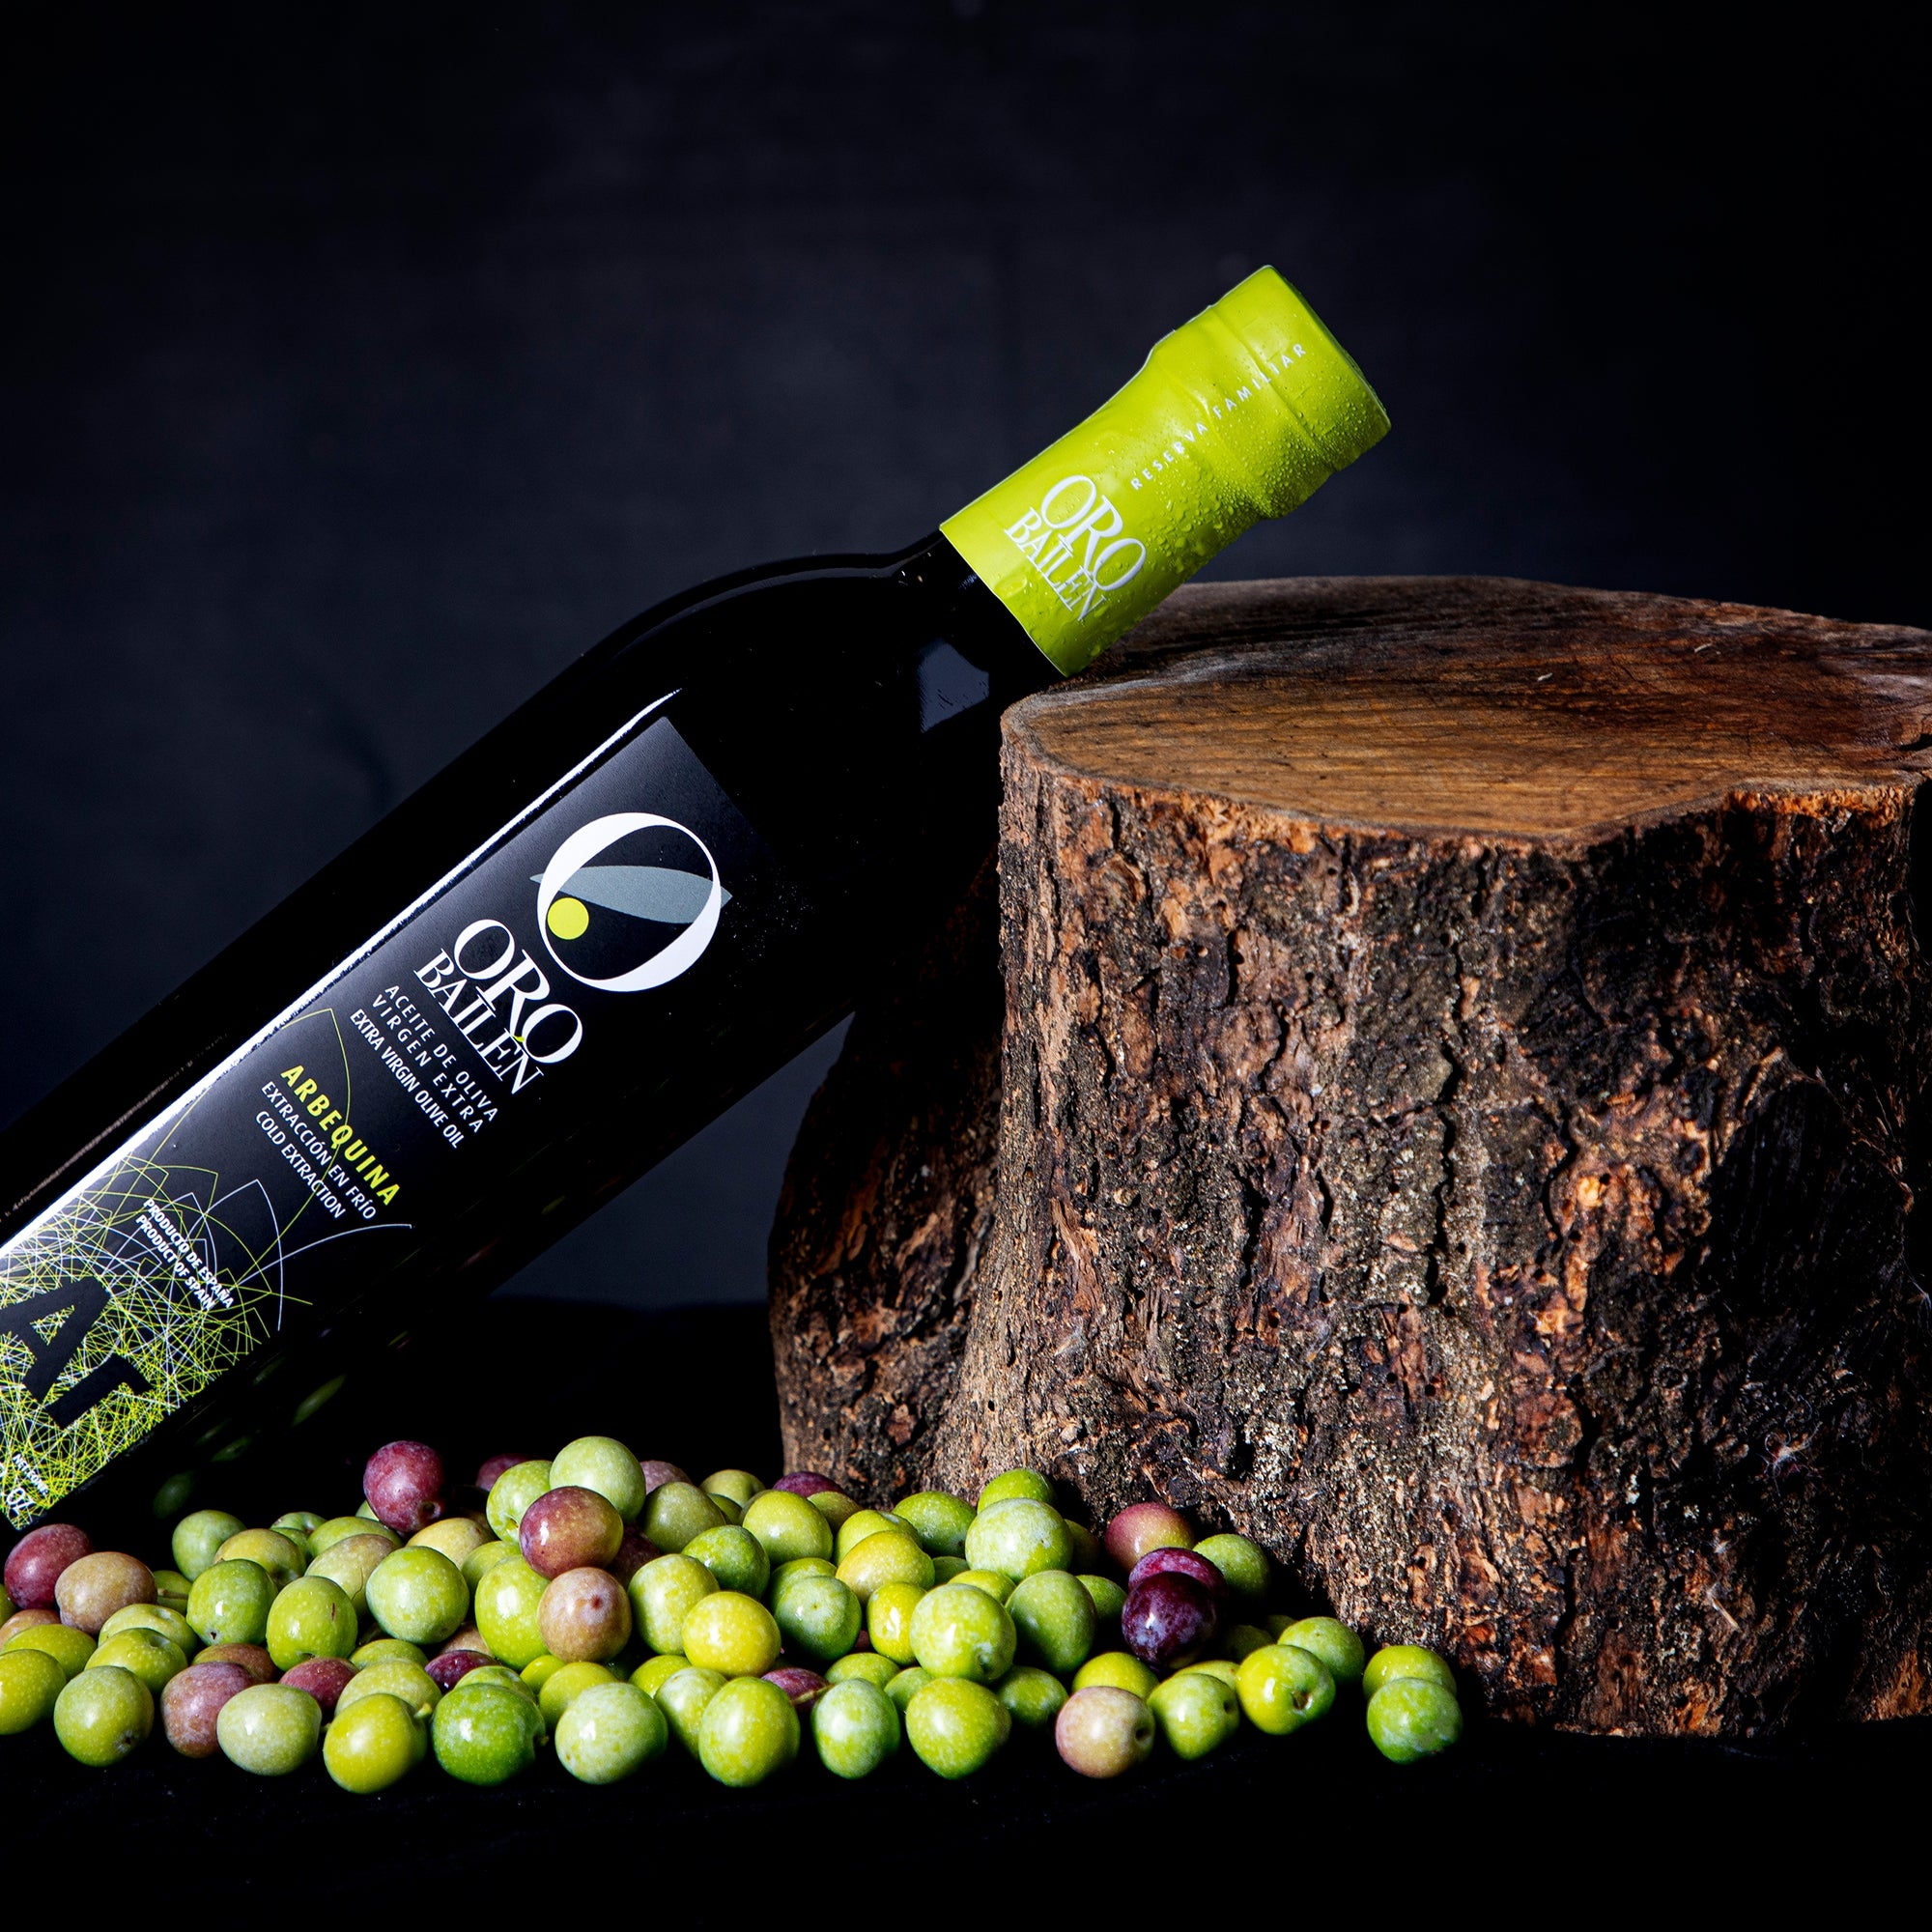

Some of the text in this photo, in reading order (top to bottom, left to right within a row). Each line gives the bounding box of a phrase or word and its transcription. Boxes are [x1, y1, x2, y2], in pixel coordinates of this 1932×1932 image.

[1130, 343, 1306, 491] RESERVA FAMILIAR
[1040, 474, 1147, 592] ORO
[384, 985, 498, 1122] ACEITE DE OLIVA
[454, 919, 582, 1063] ORO
[350, 1009, 465, 1149] EXTRA VIRGIN OLIVE OIL
[372, 994, 484, 1133] VIRGEN EXTRA
[255, 1110, 347, 1219] COLD EXTRACTION
[261, 1081, 377, 1219] EXTRACCIÓN EN FRÍO
[280, 1065, 401, 1206] ARBEQUINA
[135, 1214, 215, 1311] PRODUCT OF SPAIN
[143, 1198, 234, 1309] PRODUCTO DE ESPAÑA
